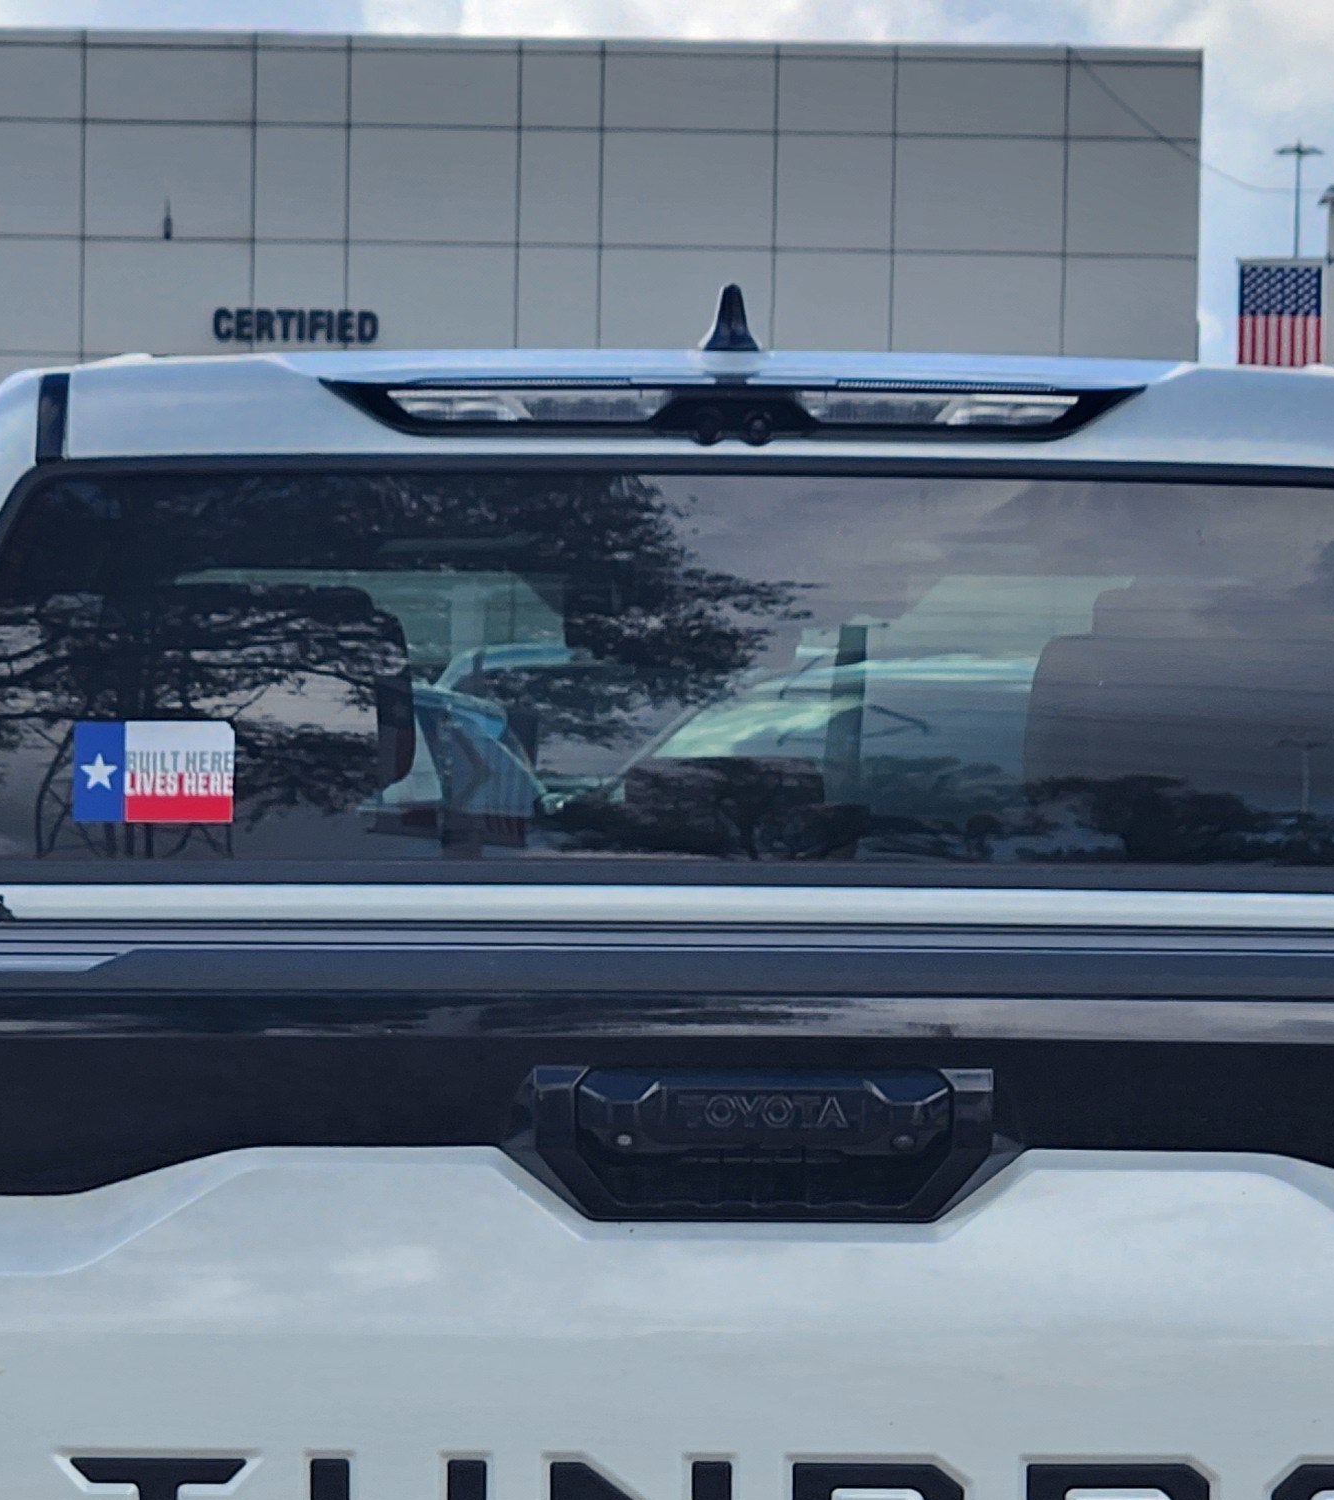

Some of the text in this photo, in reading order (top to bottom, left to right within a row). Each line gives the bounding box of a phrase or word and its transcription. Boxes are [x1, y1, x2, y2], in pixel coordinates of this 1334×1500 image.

[213, 307, 379, 343] CERTIFIED
[125, 750, 234, 773] BUILT HERE
[124, 772, 234, 796] LIVES HERE
[678, 1094, 848, 1128] TOYOTA
